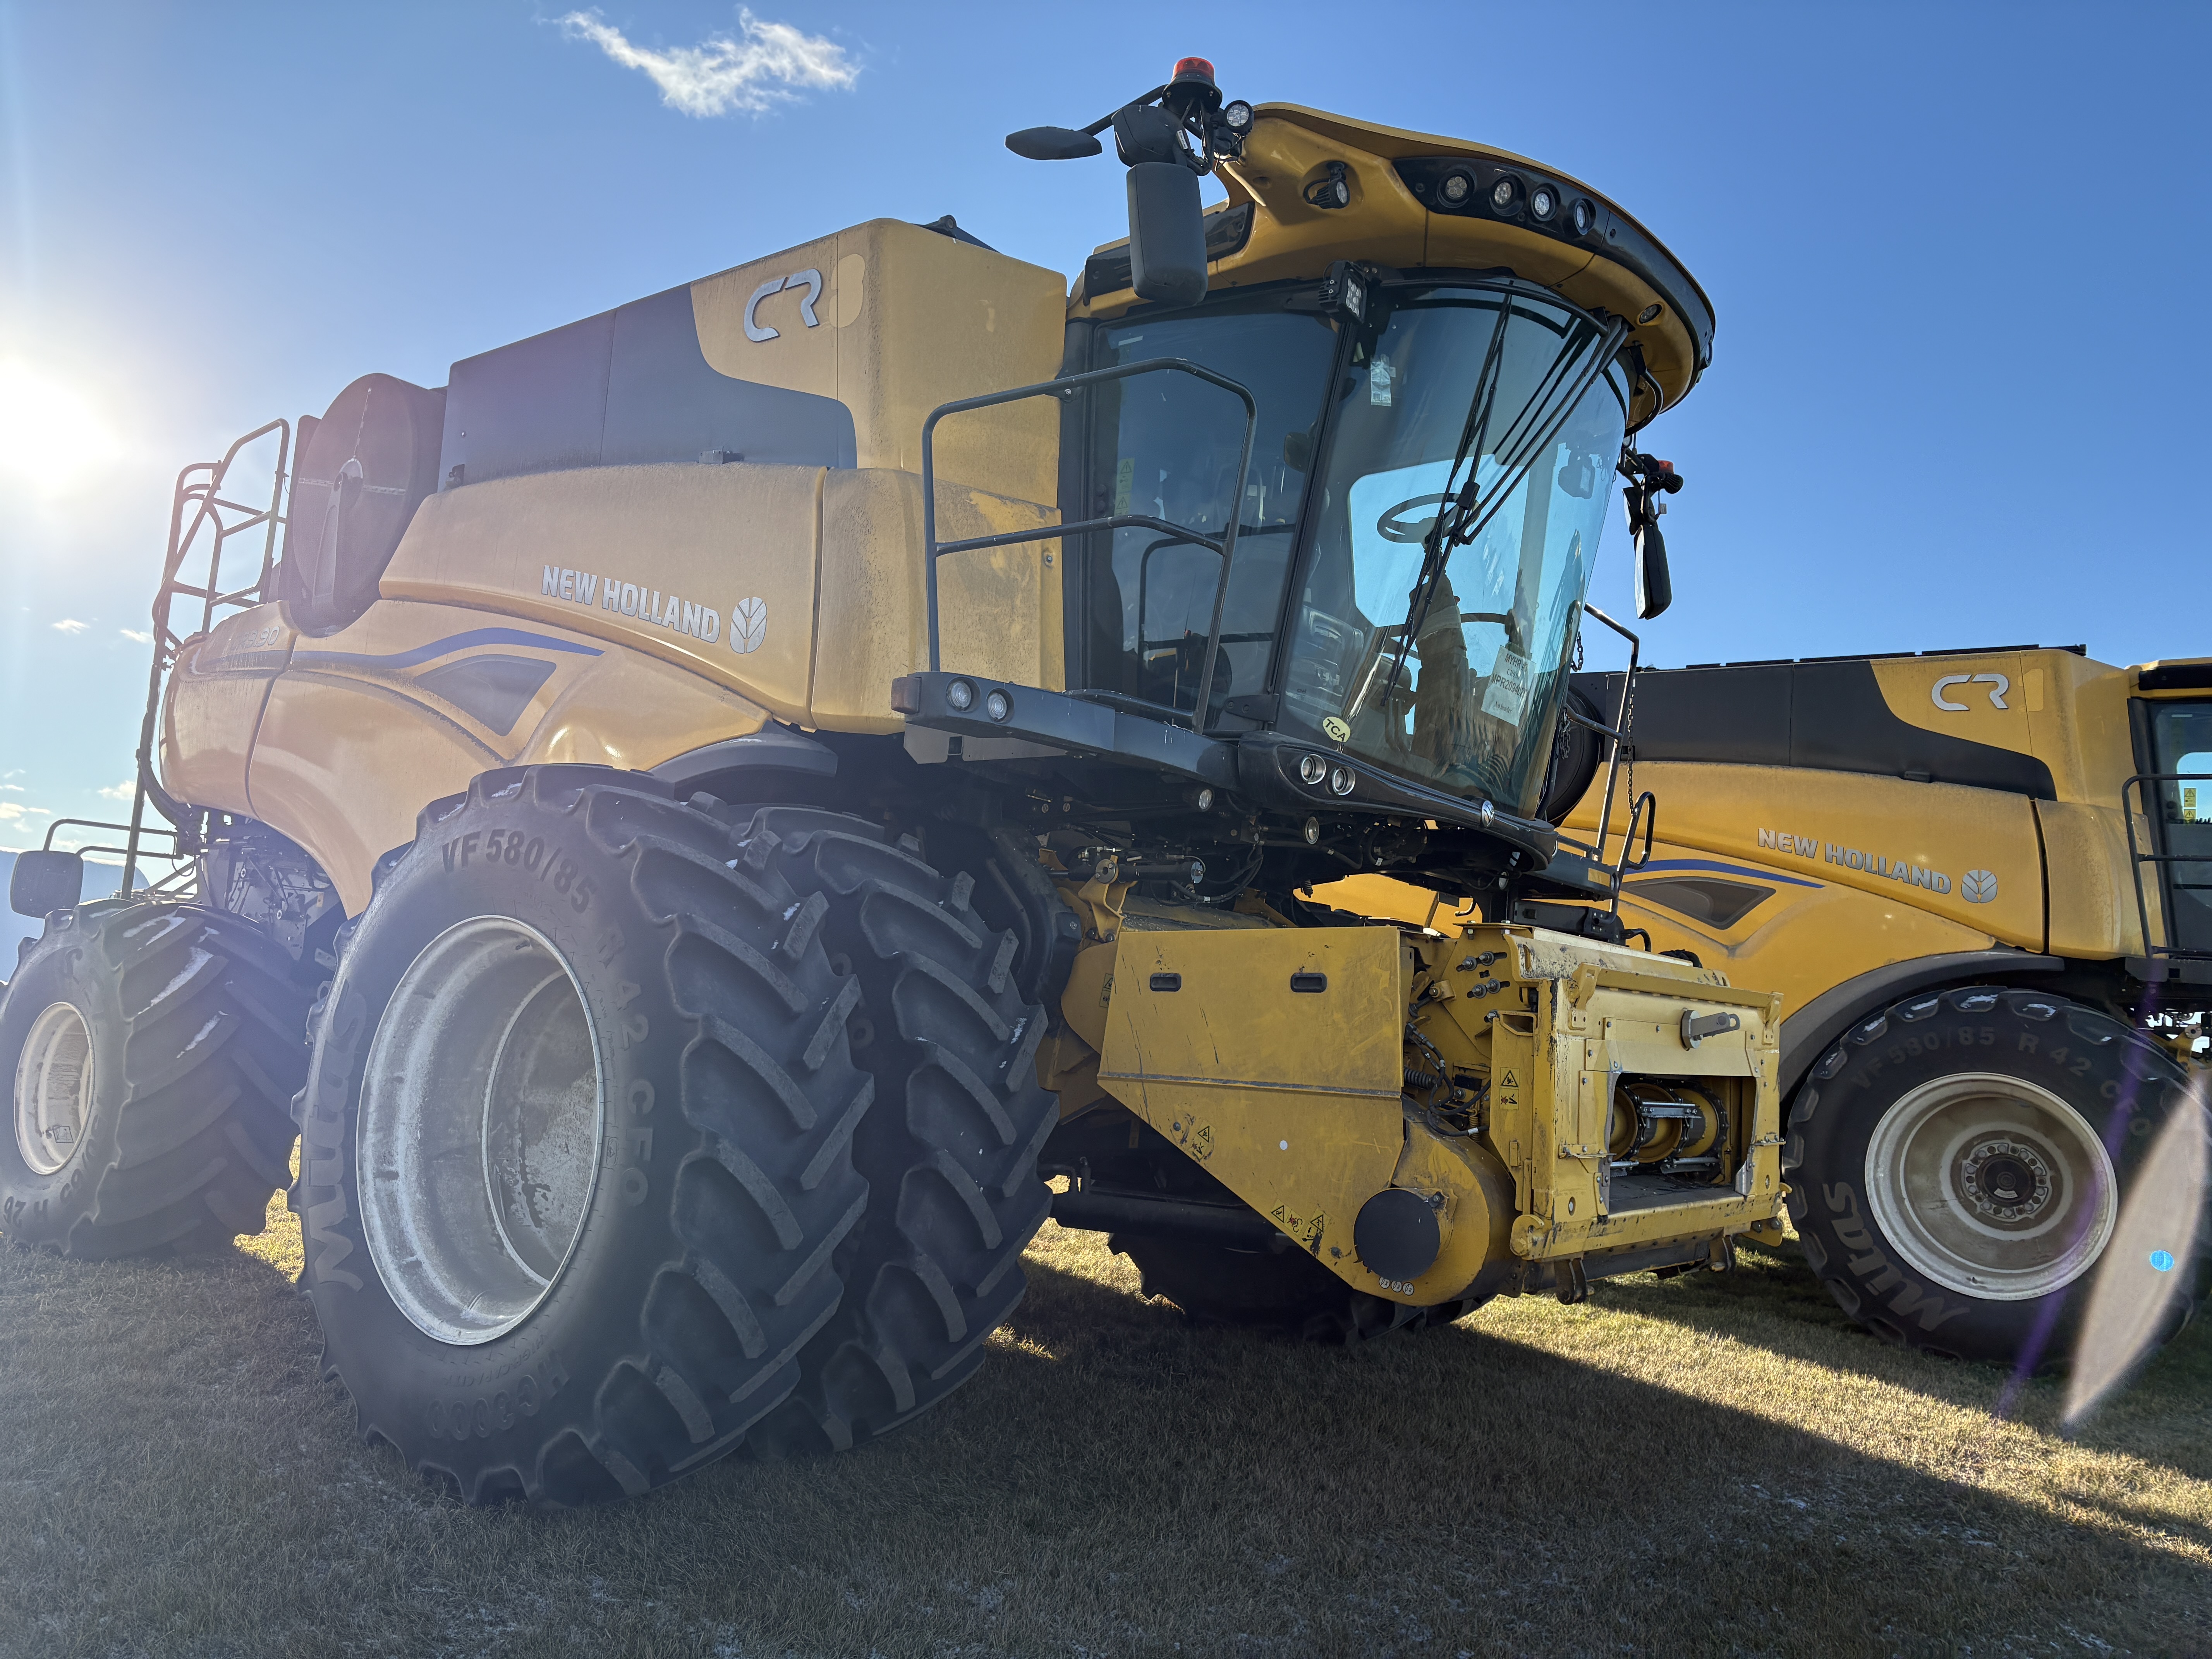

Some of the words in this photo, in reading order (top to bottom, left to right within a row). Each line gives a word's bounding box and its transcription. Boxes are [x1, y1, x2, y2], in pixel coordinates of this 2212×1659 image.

[744, 268, 821, 342] CR
[542, 565, 597, 605] NEW
[602, 577, 720, 643] HOLLAND
[1504, 653, 1522, 669] MYHR
[1931, 673, 2009, 711] CR
[1326, 719, 1346, 742] TCA
[442, 831, 481, 874] VF
[486, 829, 599, 914] 580/85
[1758, 828, 1818, 859] NEW
[1825, 843, 1951, 895] HOLLAND
[594, 929, 625, 969] R
[615, 980, 649, 1051] 42
[1850, 1059, 1884, 1089] VF
[1889, 1026, 1996, 1064] 580/85
[2018, 1032, 2040, 1054] R
[2049, 1046, 2092, 1077] 42
[306, 978, 367, 1293] Mitas
[620, 1079, 655, 1207] CFO
[1822, 1182, 1971, 1332] Mitas
